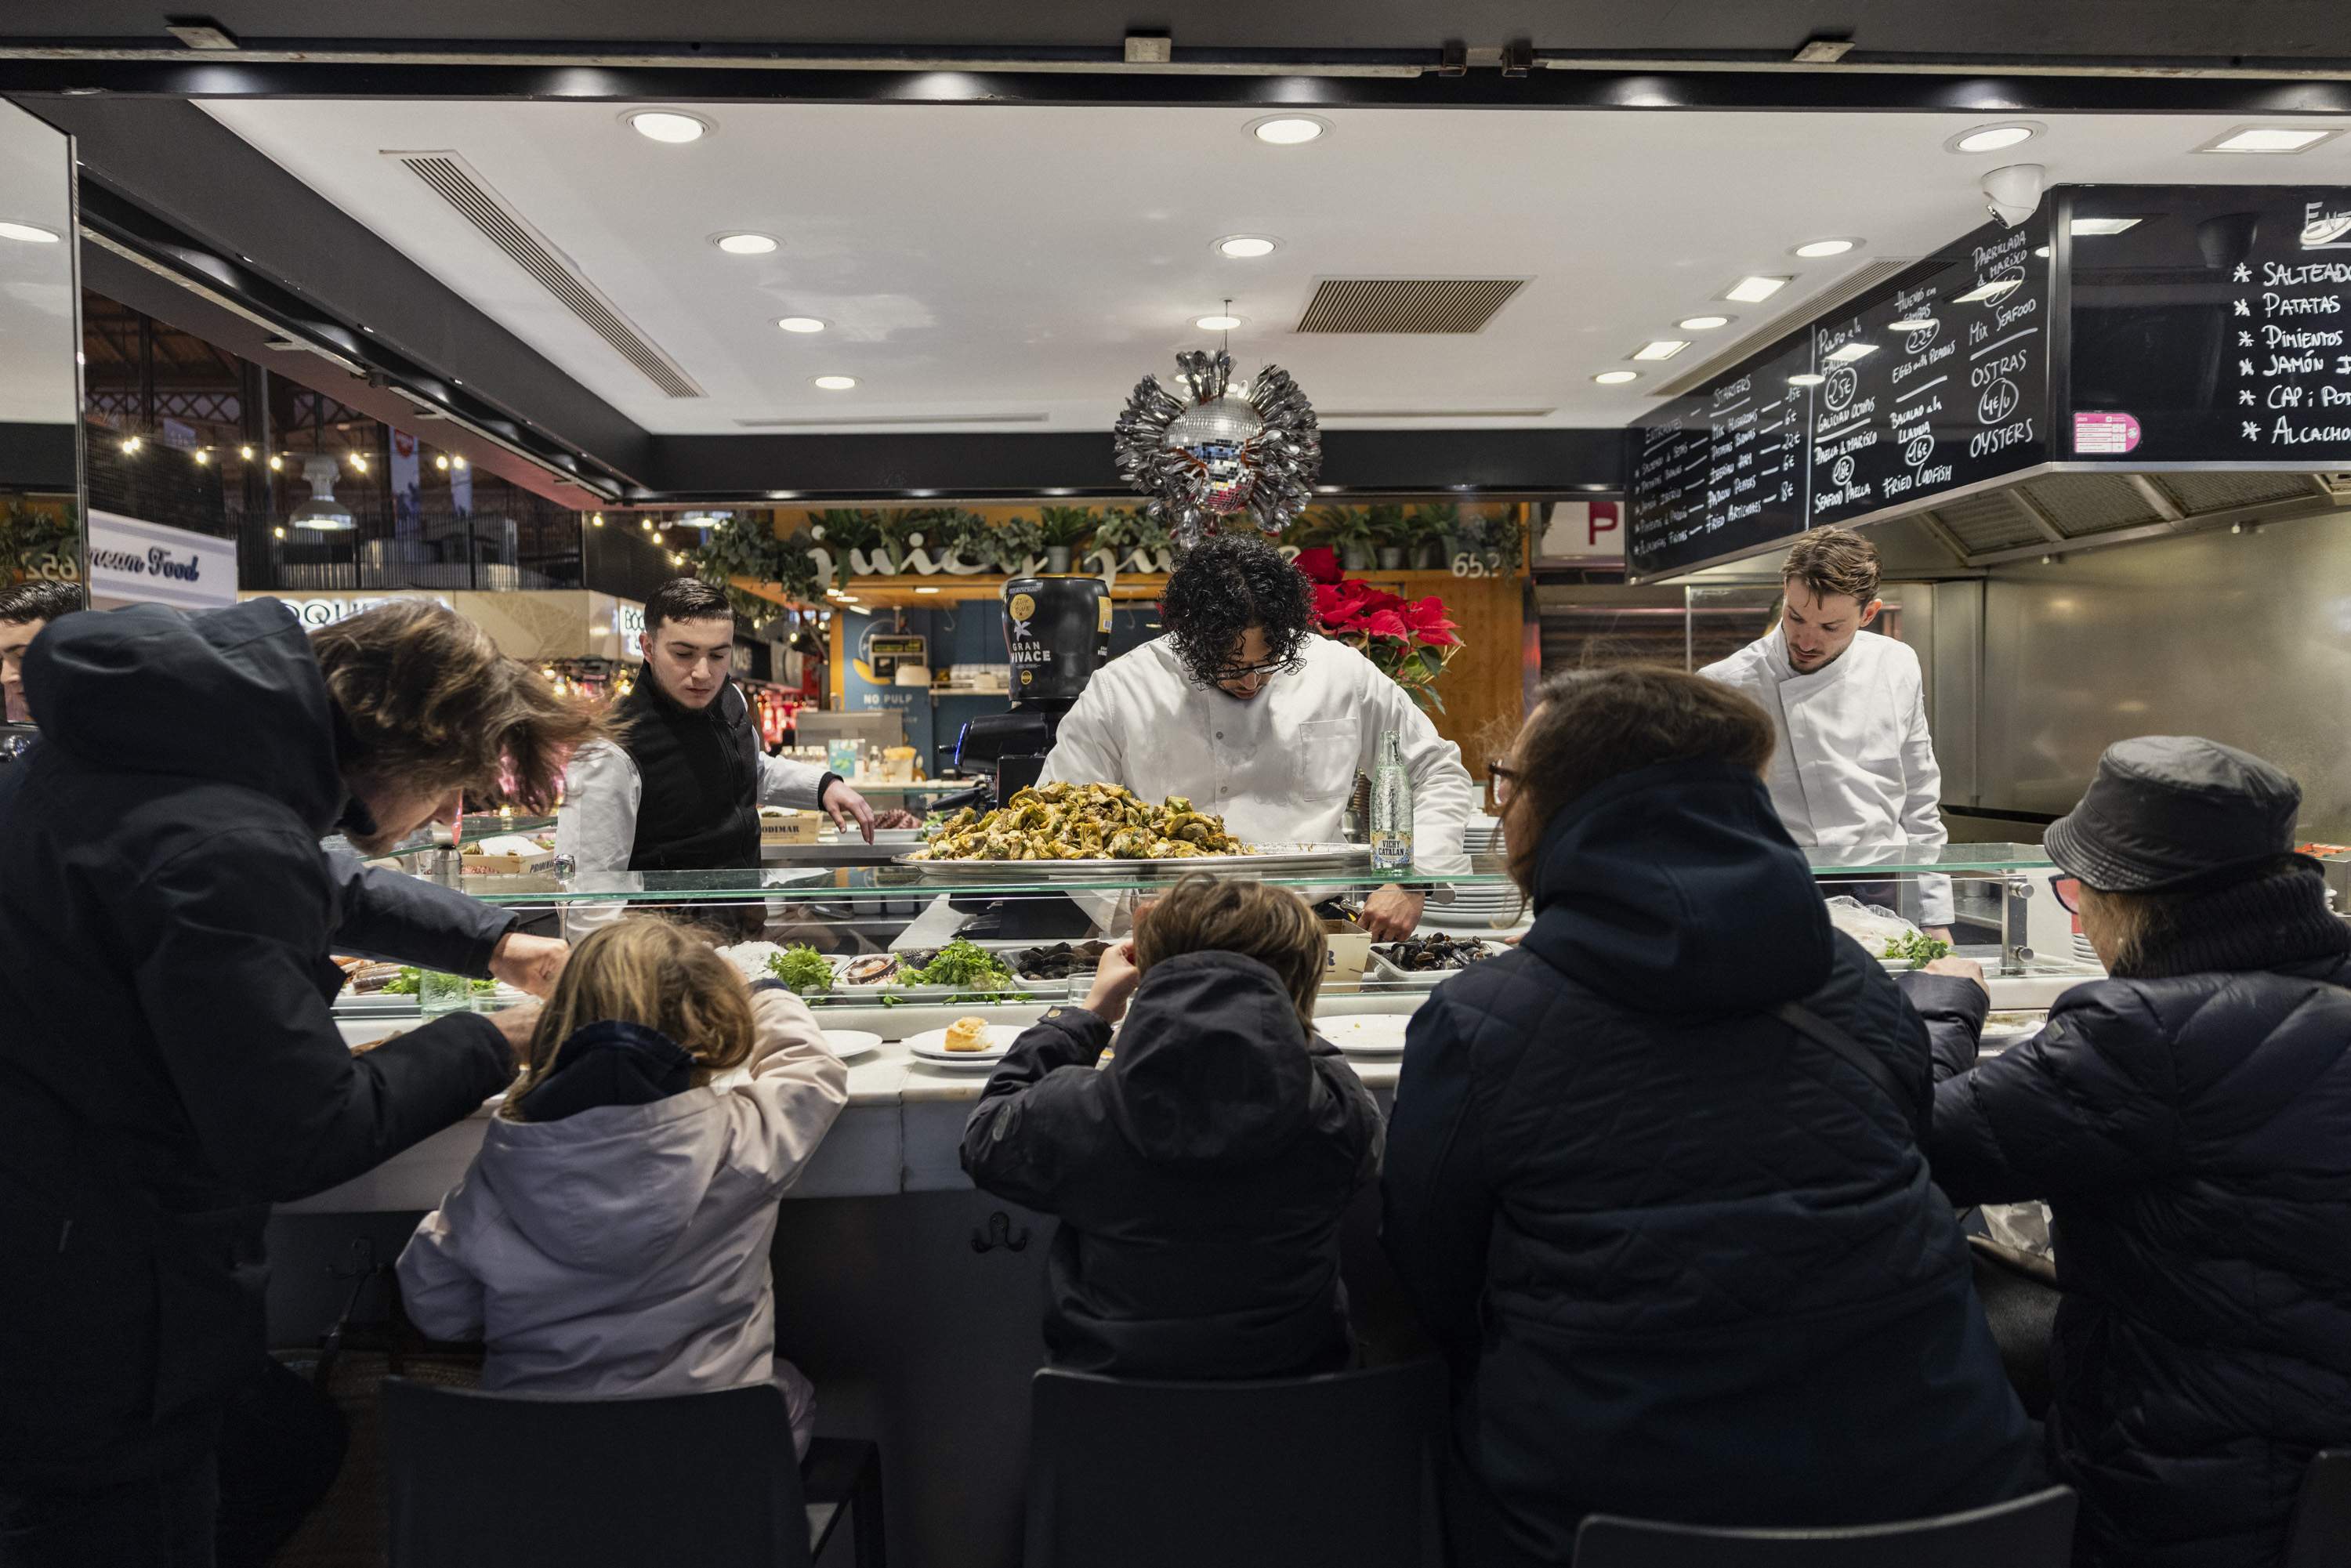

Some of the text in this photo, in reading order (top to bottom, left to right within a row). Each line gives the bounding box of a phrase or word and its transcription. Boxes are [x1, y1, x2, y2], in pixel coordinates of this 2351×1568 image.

[1996, 298, 2036, 331] SEAFOOD
[2262, 292, 2341, 317] PATATAS
[1971, 349, 2027, 387] OSTRAS
[2262, 349, 2324, 376] JAMÓN
[1713, 374, 1751, 407] STARTERS
[2267, 385, 2302, 409] CAP
[1969, 418, 2034, 458] OYSTERS
[2271, 415, 2351, 445] ALCACHO
[148, 546, 199, 581] Food
[1011, 650, 1051, 663] VIVACE
[1012, 641, 1041, 652] GRAN
[864, 693, 913, 704] NO PULP
[1378, 848, 1404, 856] CATALAN
[1382, 840, 1400, 849] VICHY
